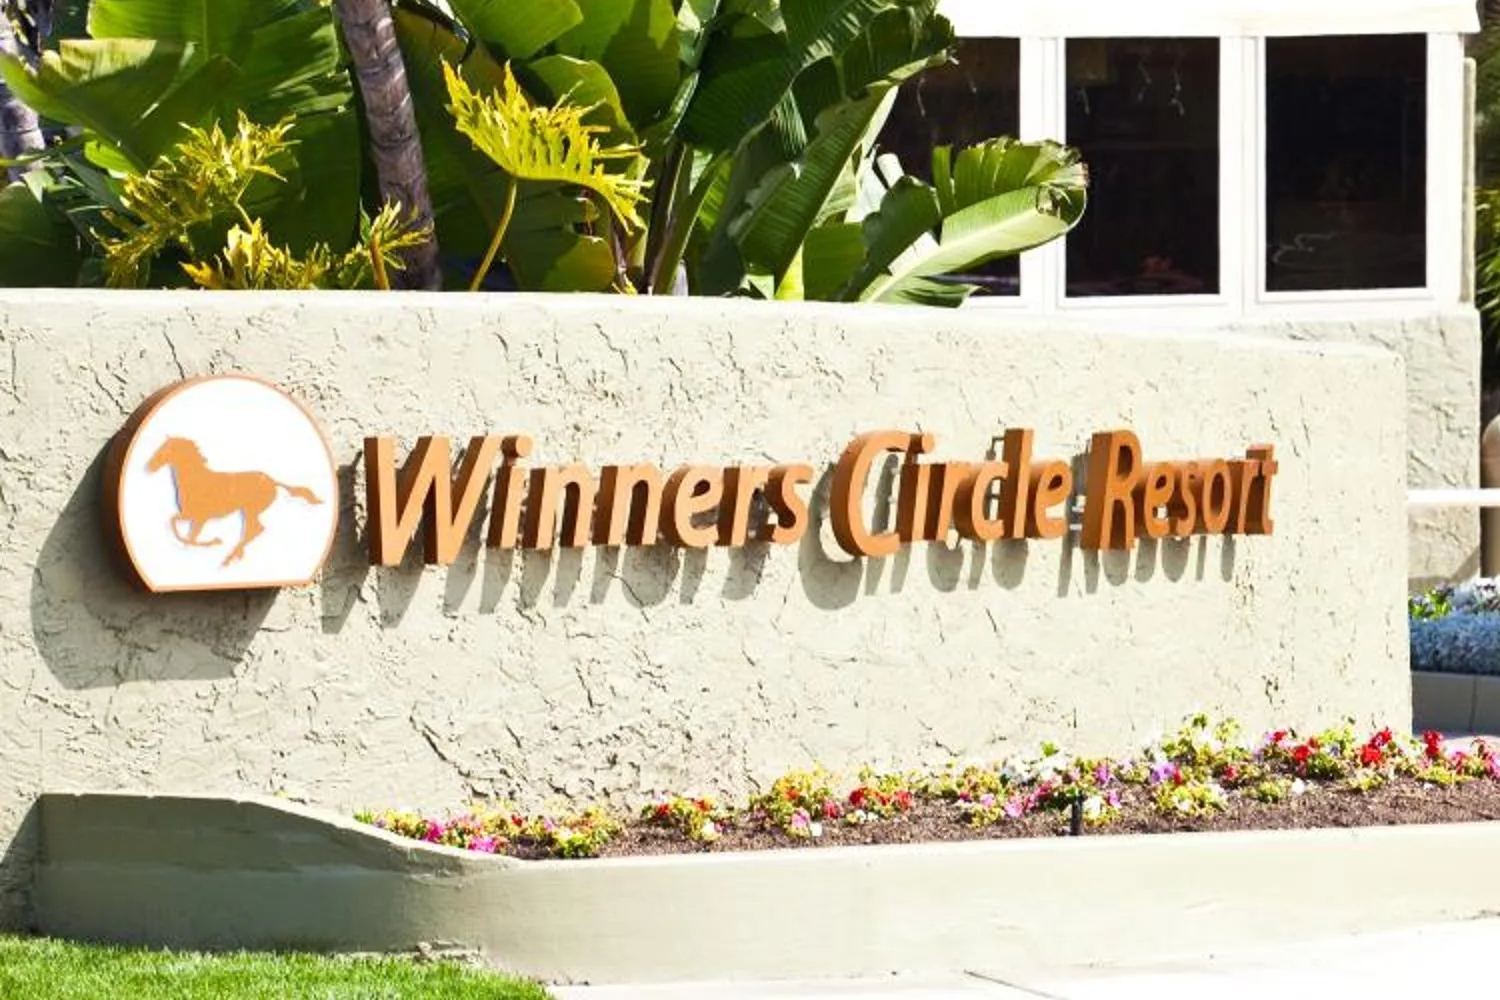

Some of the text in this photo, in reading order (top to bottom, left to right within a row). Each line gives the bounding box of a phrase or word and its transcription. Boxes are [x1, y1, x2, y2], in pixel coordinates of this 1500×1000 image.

[363, 428, 1279, 567] Winners Circle Resort
